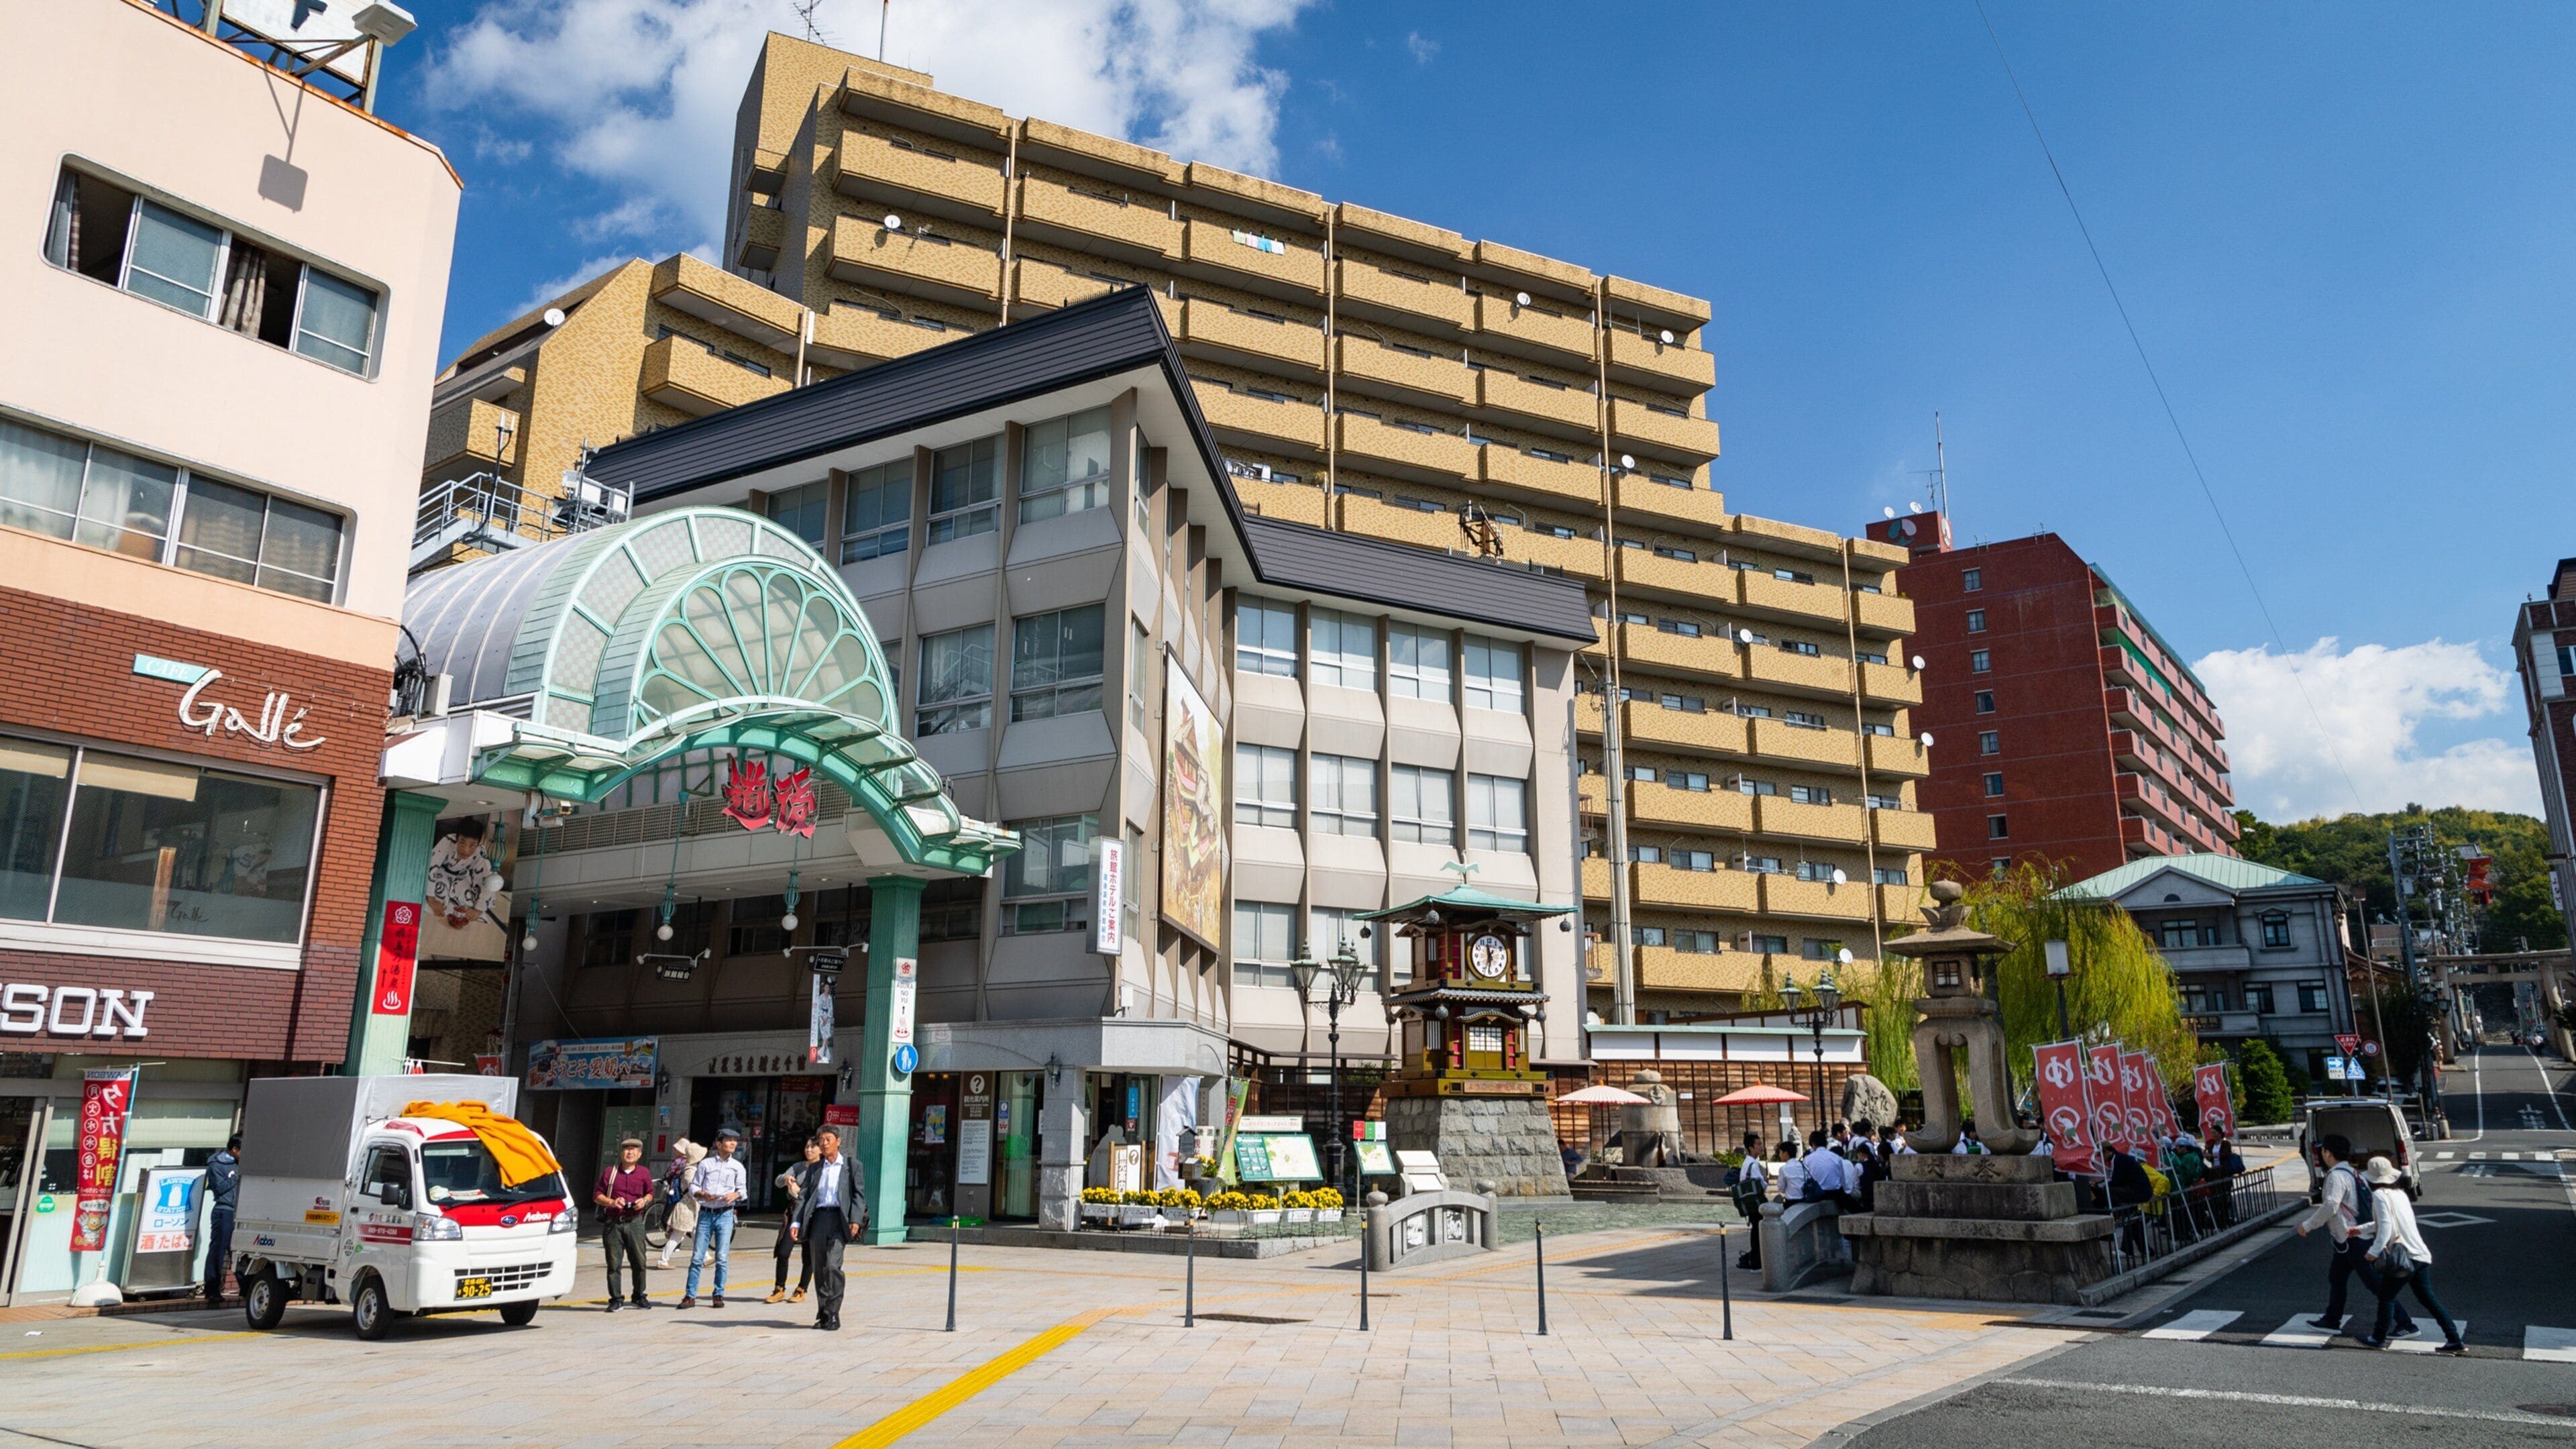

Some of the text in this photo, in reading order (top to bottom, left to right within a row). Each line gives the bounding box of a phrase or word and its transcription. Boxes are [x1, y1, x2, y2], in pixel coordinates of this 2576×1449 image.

[178, 669, 327, 748] Gallé
[721, 752, 819, 840] 道後
[1108, 849, 1118, 944] 旅館ホテルご案内
[0, 981, 155, 1037] SON
[547, 1056, 631, 1080] ようこそ愛媛へ
[2044, 1055, 2074, 1089] ゆ
[964, 1095, 990, 1103] 観光案内所
[160, 1175, 196, 1185] LAWSON
[154, 1218, 190, 1228] ローソン
[462, 1283, 491, 1299] 90-25
